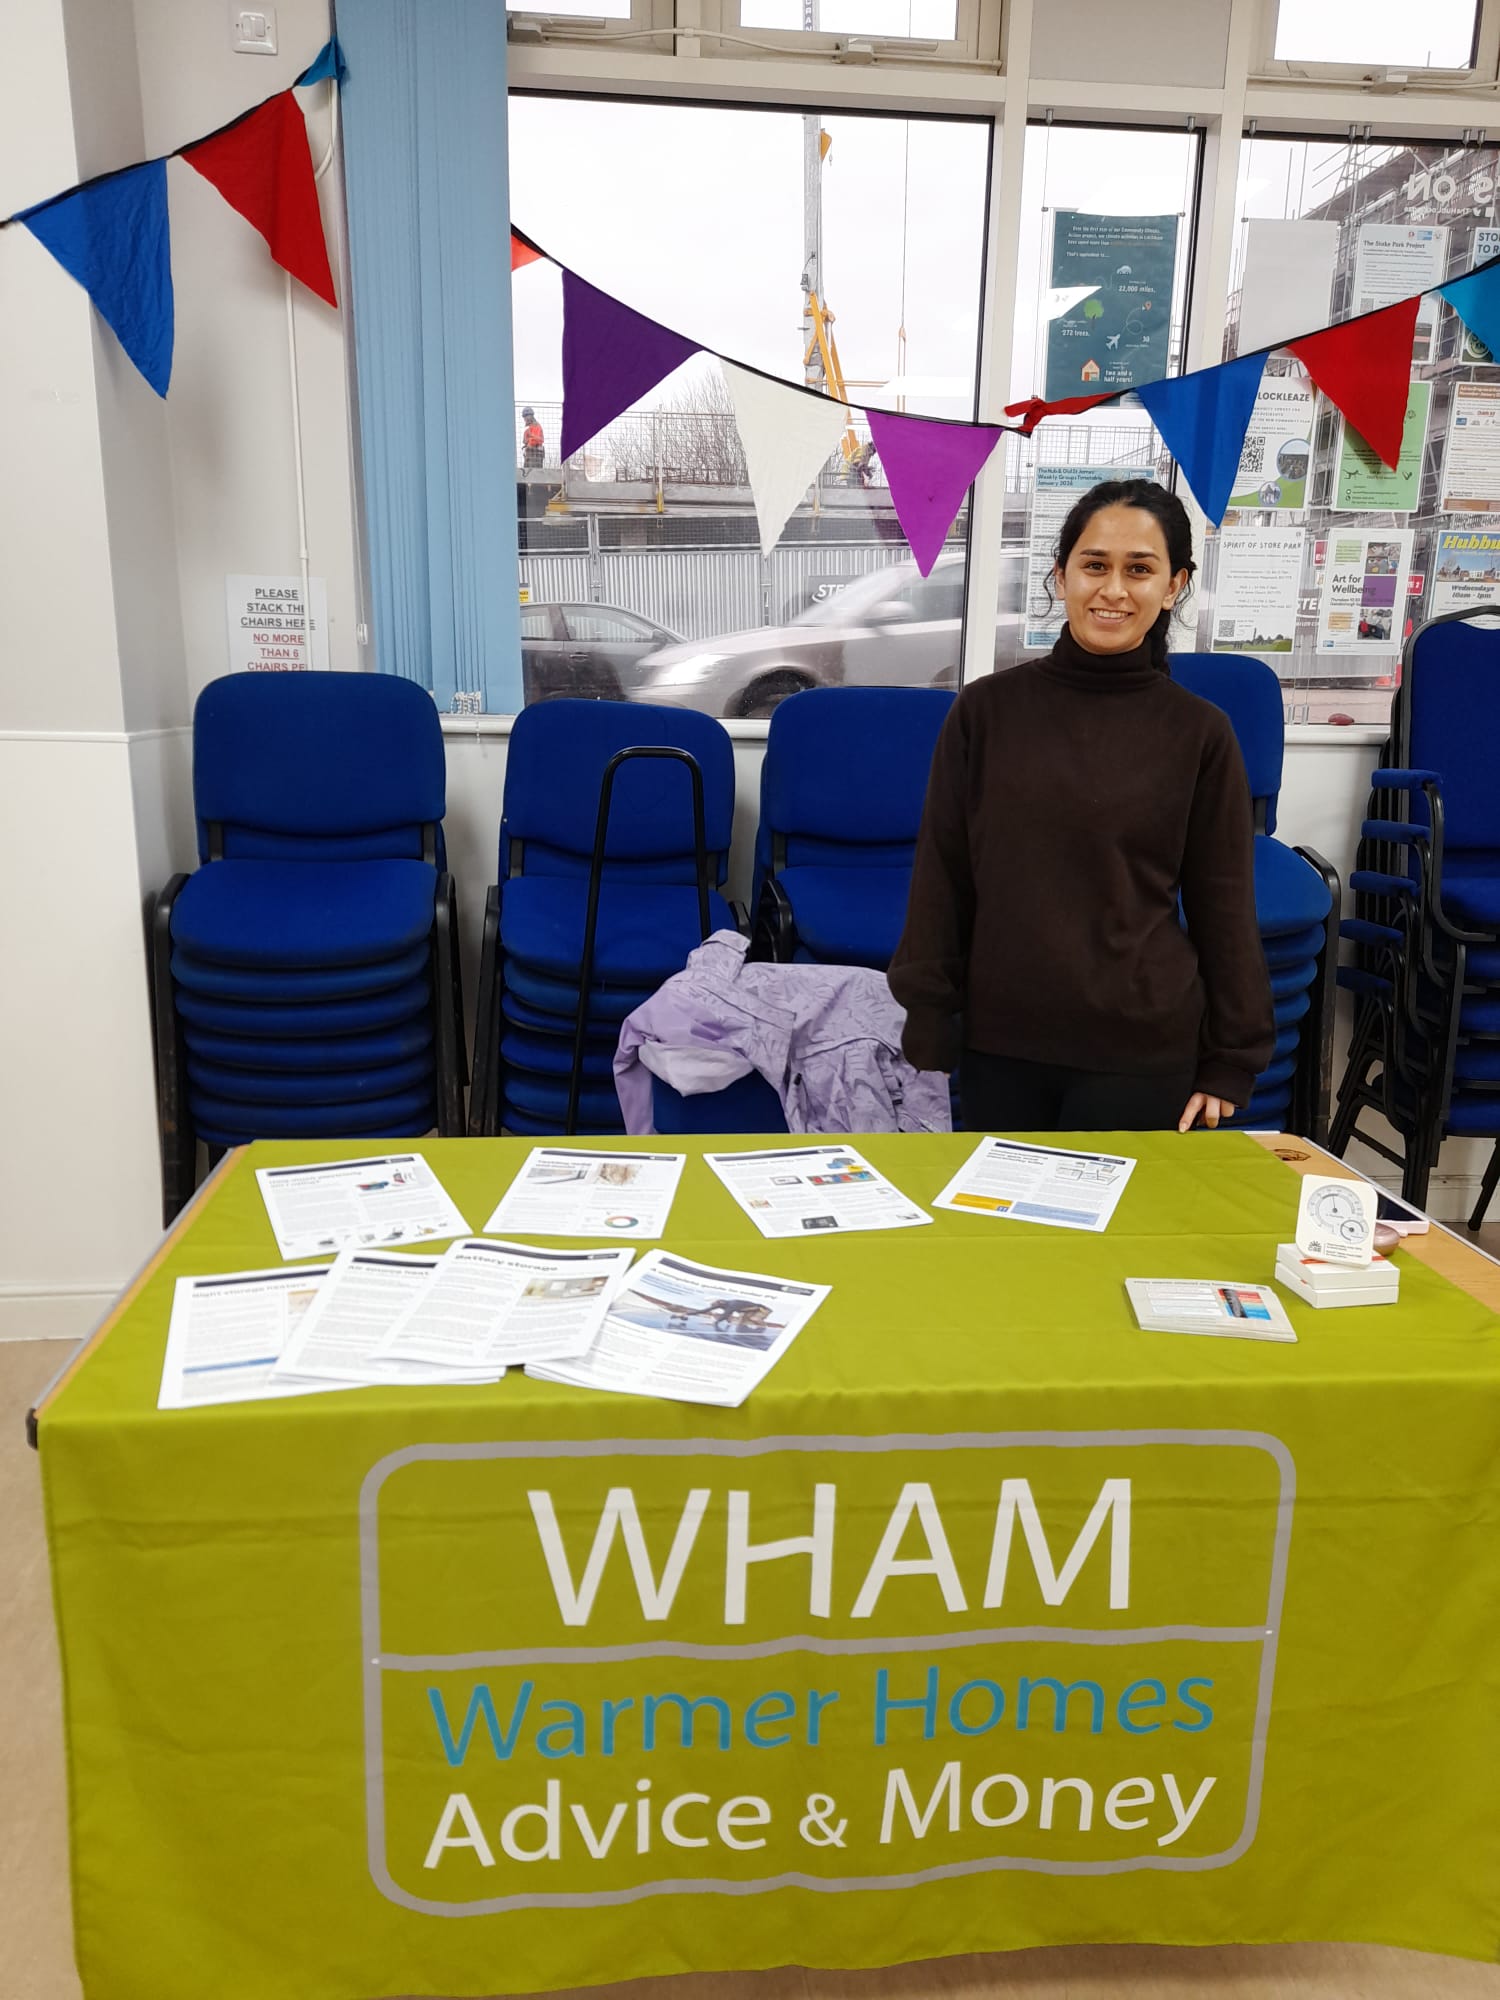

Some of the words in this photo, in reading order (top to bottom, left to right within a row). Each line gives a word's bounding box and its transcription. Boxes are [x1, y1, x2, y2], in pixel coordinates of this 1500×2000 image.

[1477, 244, 1490, 254] TO
[1257, 392, 1310, 402] LOCKLEAZE
[1223, 541, 1245, 549] SPIRIT
[1332, 574, 1348, 584] Art
[1349, 574, 1362, 584] for
[255, 588, 299, 599] PLEASE
[247, 603, 283, 612] STACK
[240, 617, 282, 627] CHAIRS
[253, 633, 269, 642] NO
[272, 634, 304, 644] MORE
[260, 648, 291, 657] THAN
[293, 649, 299, 657] 6
[247, 662, 288, 671] CHAIRS
[528, 1478, 1131, 1625] WHAM
[428, 1681, 839, 1767] Warmer
[875, 1666, 1214, 1745] Homes
[424, 1780, 772, 1869] Advice
[799, 1794, 849, 1848] &
[880, 1762, 1217, 1846] Money
